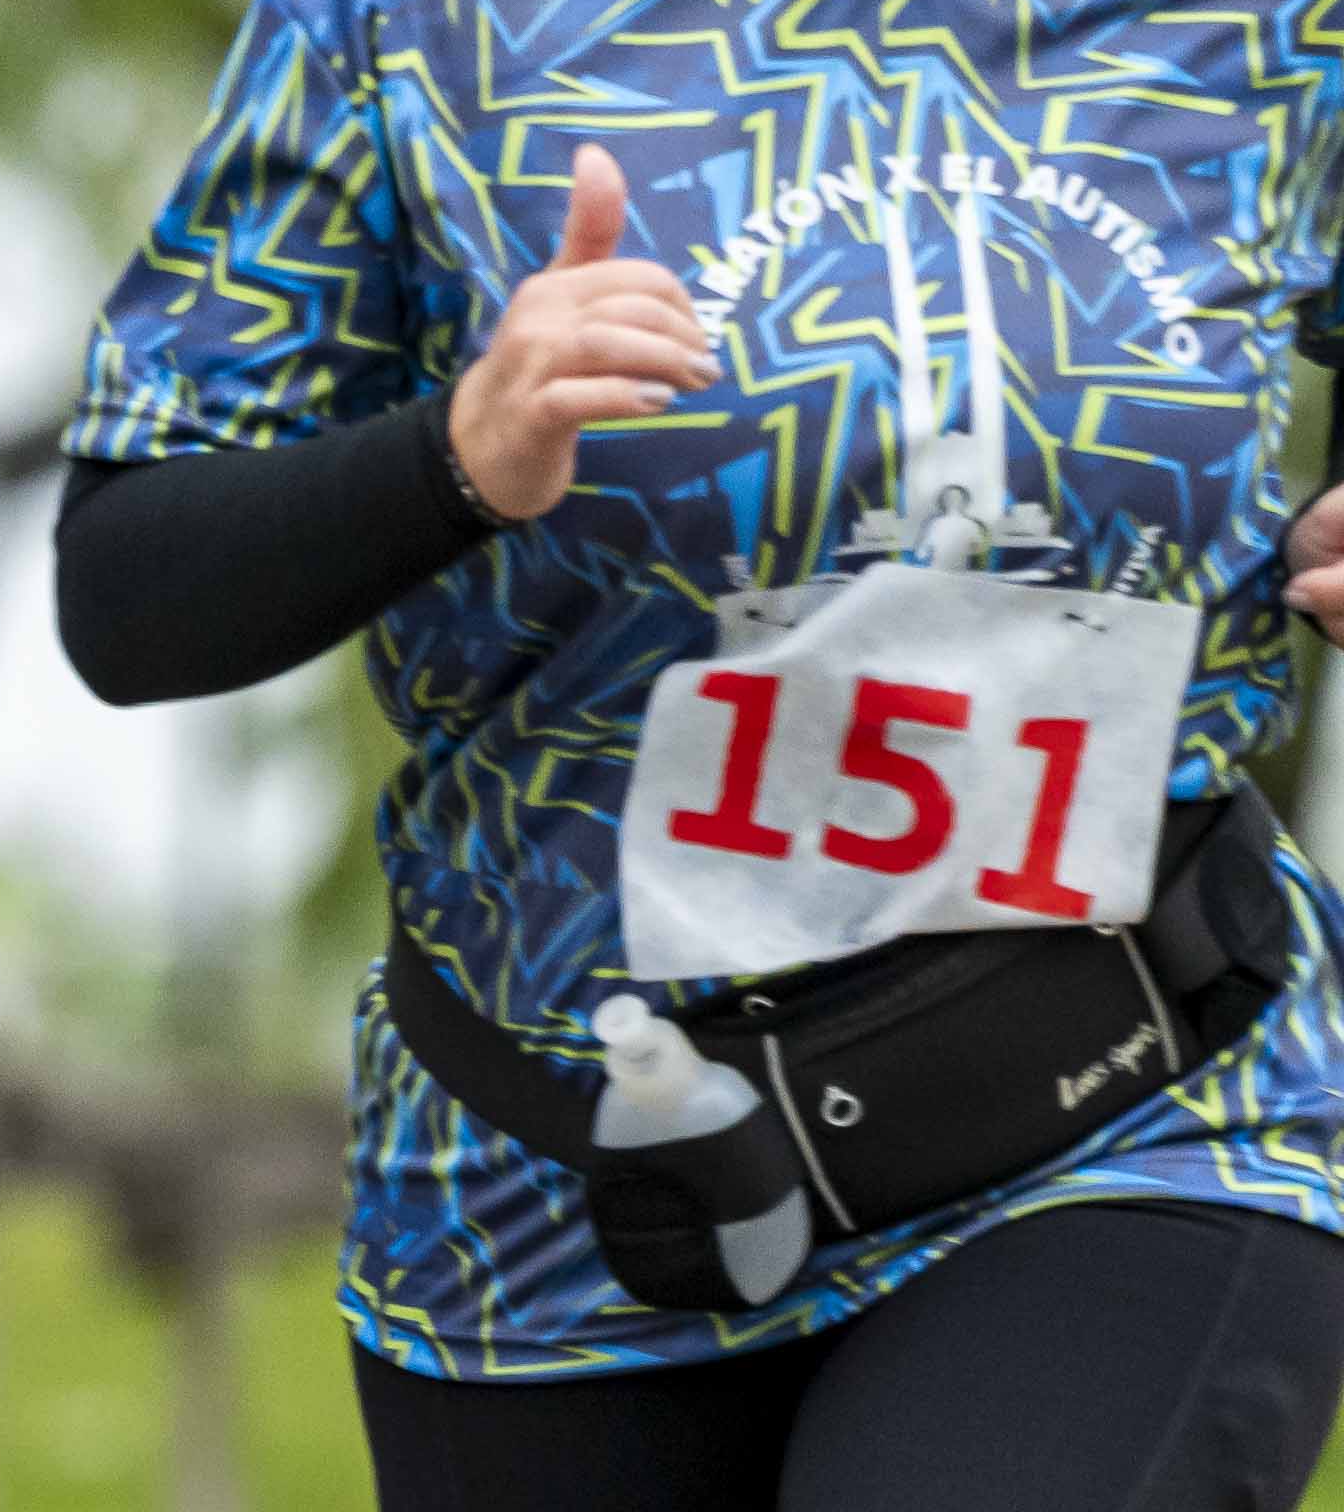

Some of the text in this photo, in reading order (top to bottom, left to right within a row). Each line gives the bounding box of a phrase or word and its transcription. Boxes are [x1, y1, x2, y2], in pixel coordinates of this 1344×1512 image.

[881, 154, 930, 194] X
[940, 152, 1005, 196] EL
[1014, 164, 1204, 367] AUTISMO
[668, 670, 1094, 920] 151
